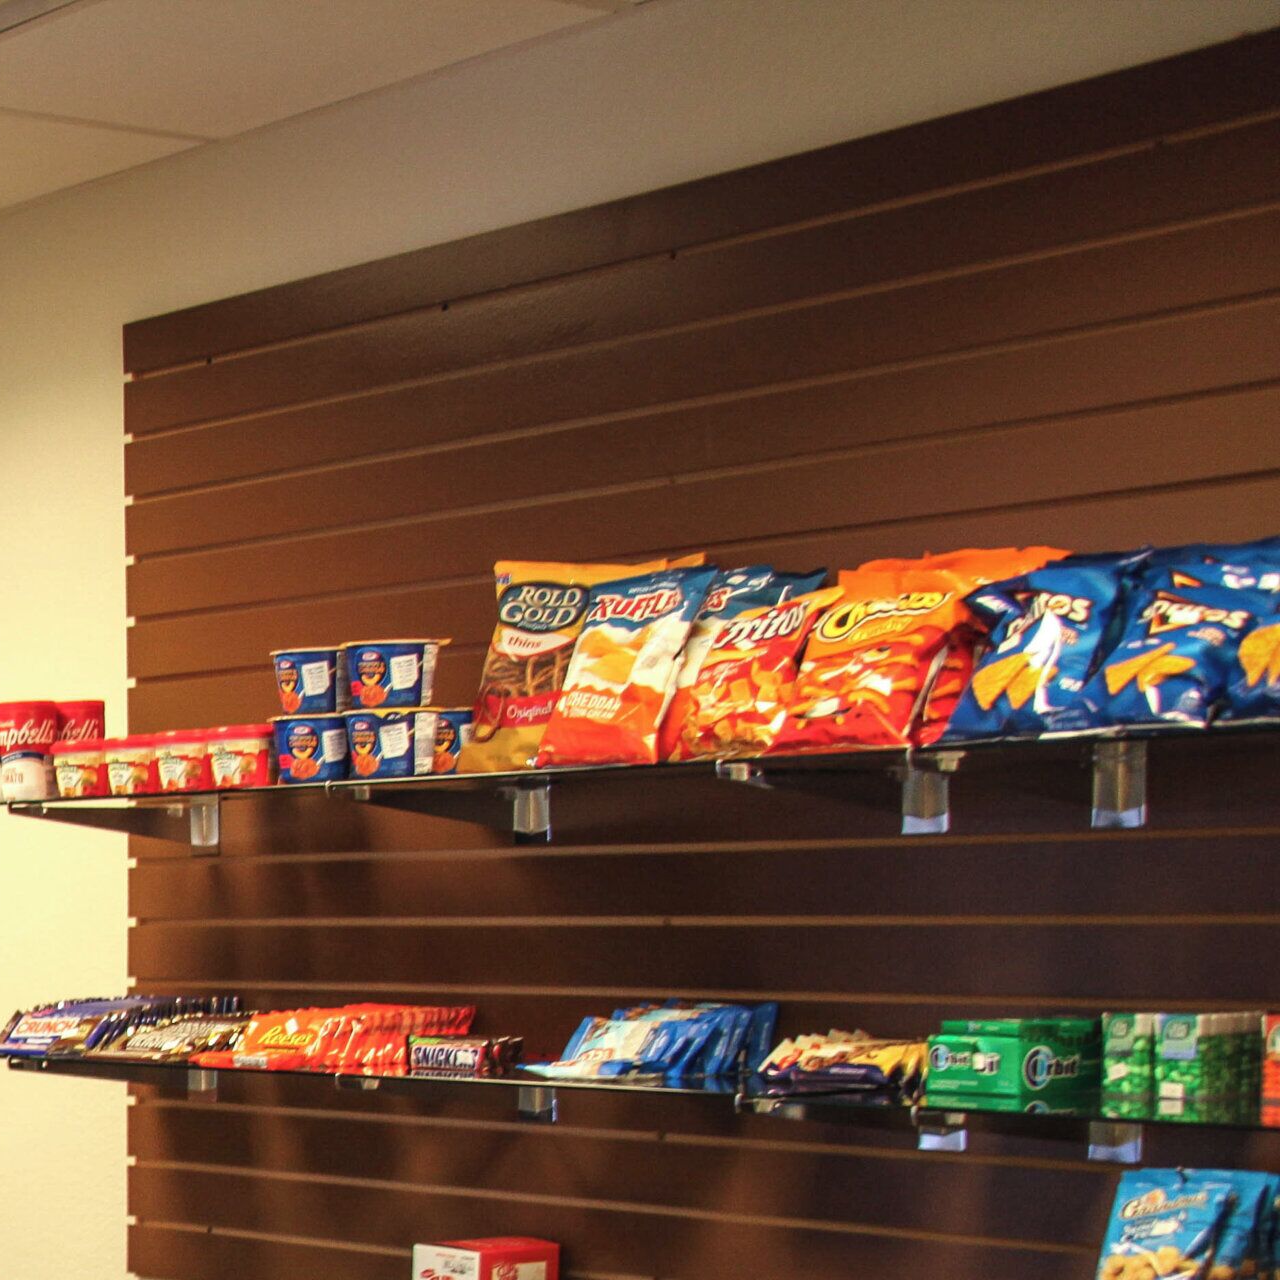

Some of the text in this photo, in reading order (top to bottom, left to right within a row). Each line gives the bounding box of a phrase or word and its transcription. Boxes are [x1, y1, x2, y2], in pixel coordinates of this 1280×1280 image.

[517, 584, 582, 608] ROLD
[500, 600, 578, 627] GOLD
[816, 591, 954, 643] Chtos
[508, 635, 543, 649] thins
[505, 699, 553, 722] Original
[61, 718, 100, 741] bell's
[15, 1019, 75, 1036] CRUNCH
[414, 1046, 479, 1069] SNICK
